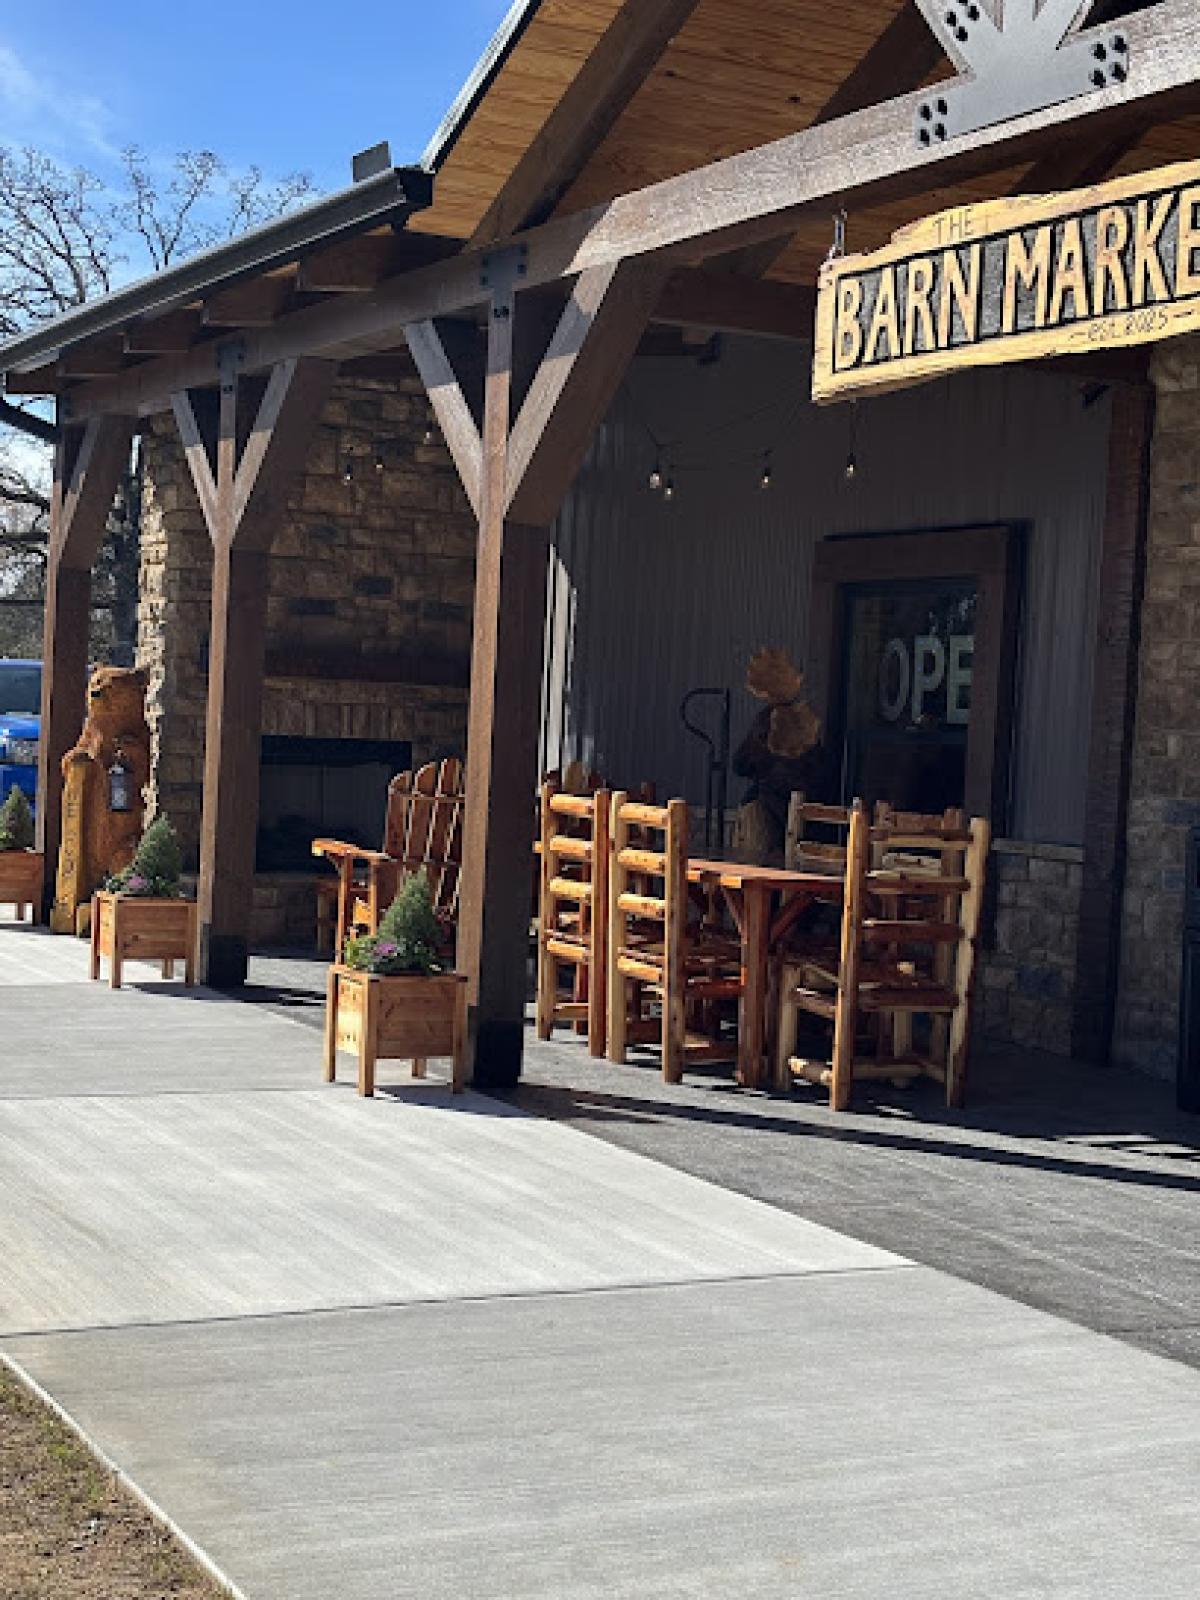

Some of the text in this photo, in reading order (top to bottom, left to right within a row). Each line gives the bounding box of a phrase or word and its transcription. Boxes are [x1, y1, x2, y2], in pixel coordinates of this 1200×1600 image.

[834, 187, 1200, 370] BARN MARKE
[933, 208, 974, 245] THE
